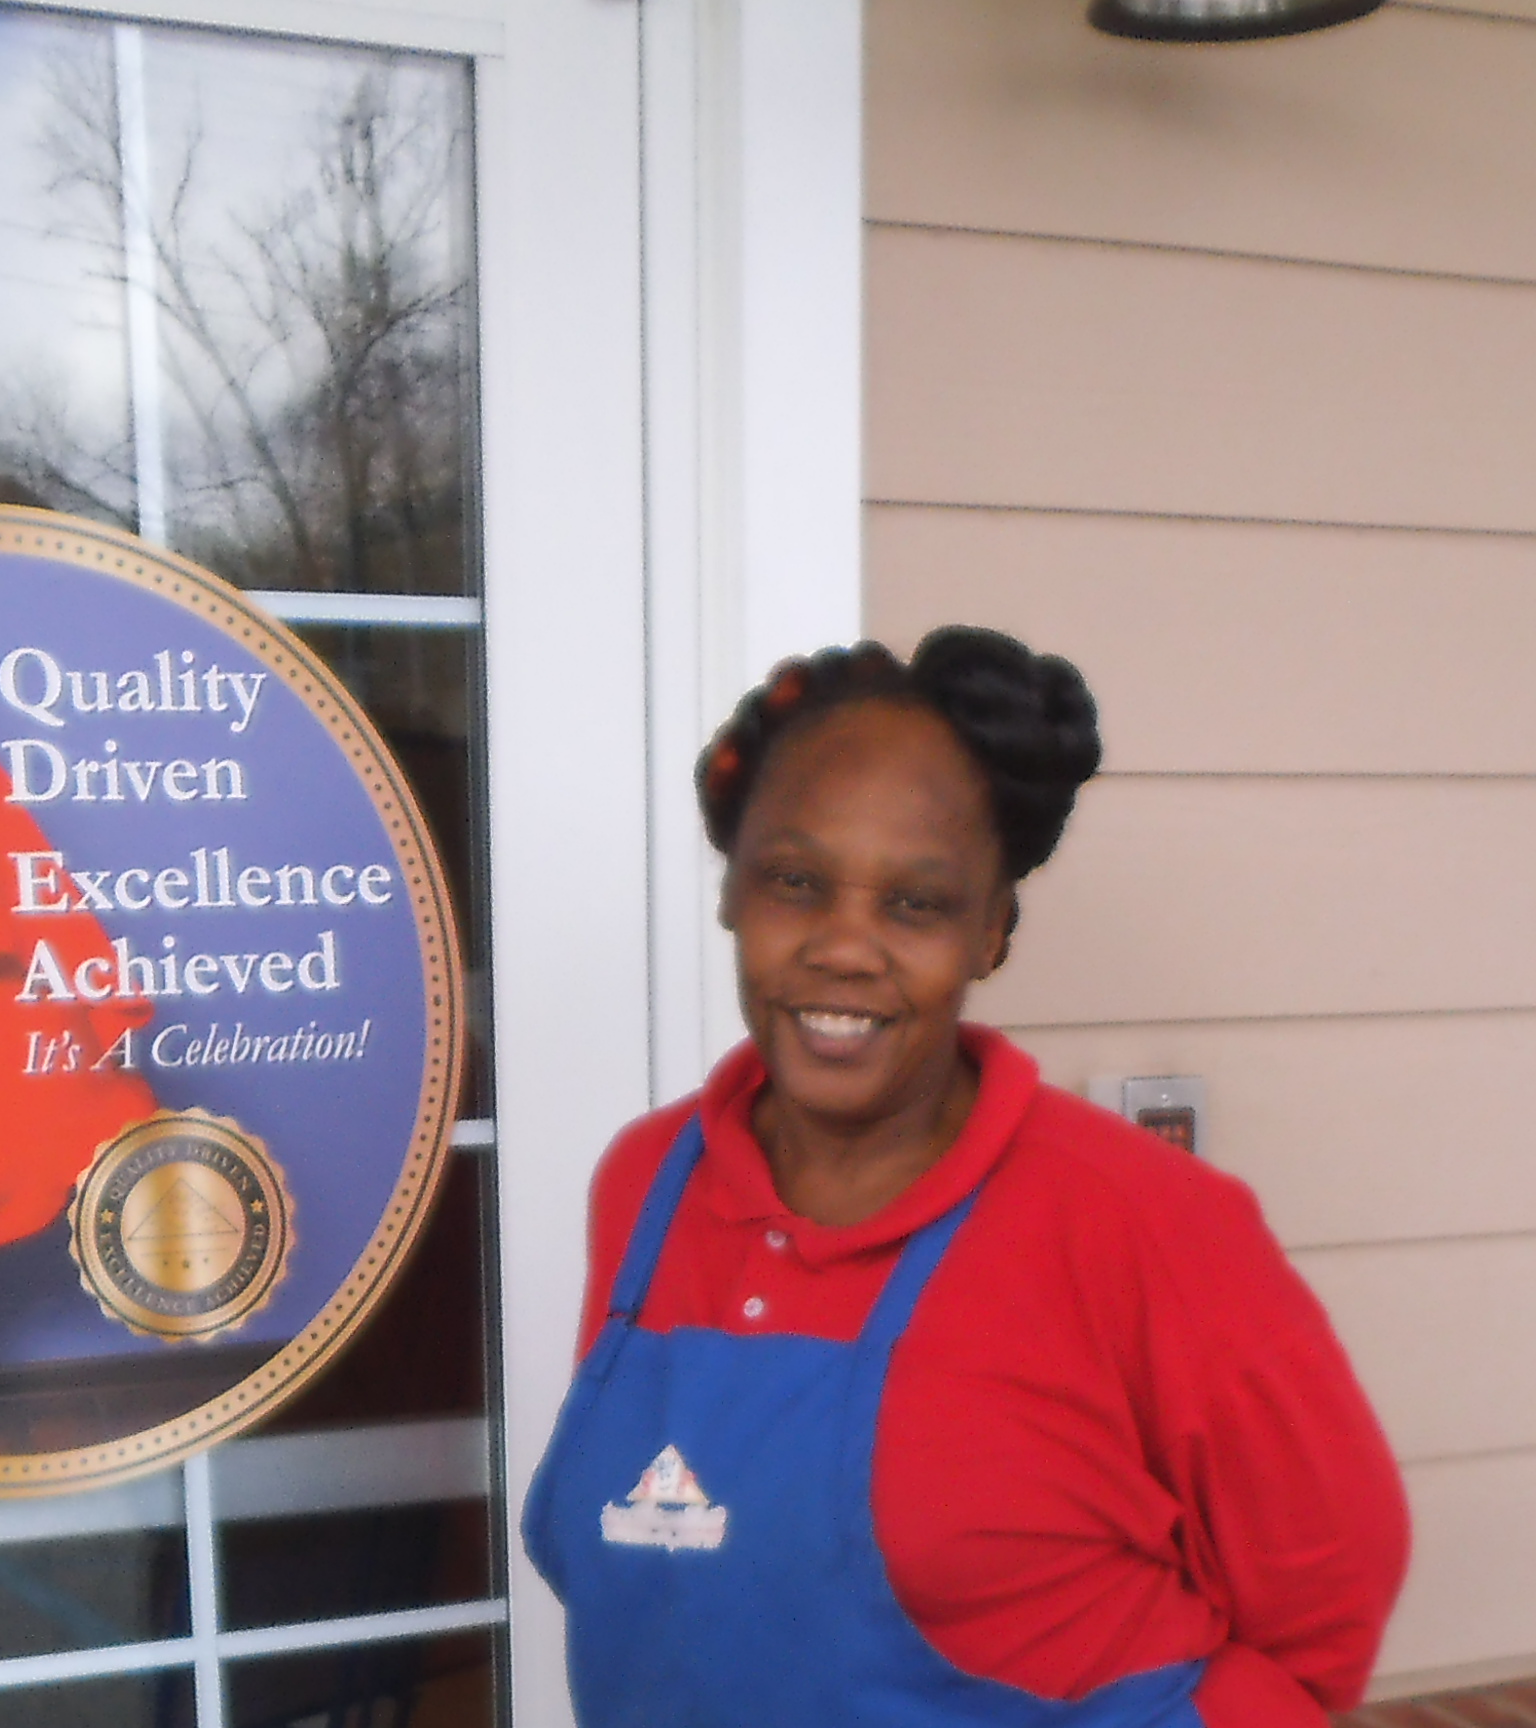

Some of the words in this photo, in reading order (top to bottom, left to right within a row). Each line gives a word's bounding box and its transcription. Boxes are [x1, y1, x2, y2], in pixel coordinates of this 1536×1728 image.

[1, 739, 247, 803] Driven
[7, 847, 392, 915] Excellence
[15, 931, 340, 1003] Achieved
[23, 1029, 81, 1075] It's
[92, 1027, 136, 1072] A
[151, 1019, 371, 1069] Celebration!
